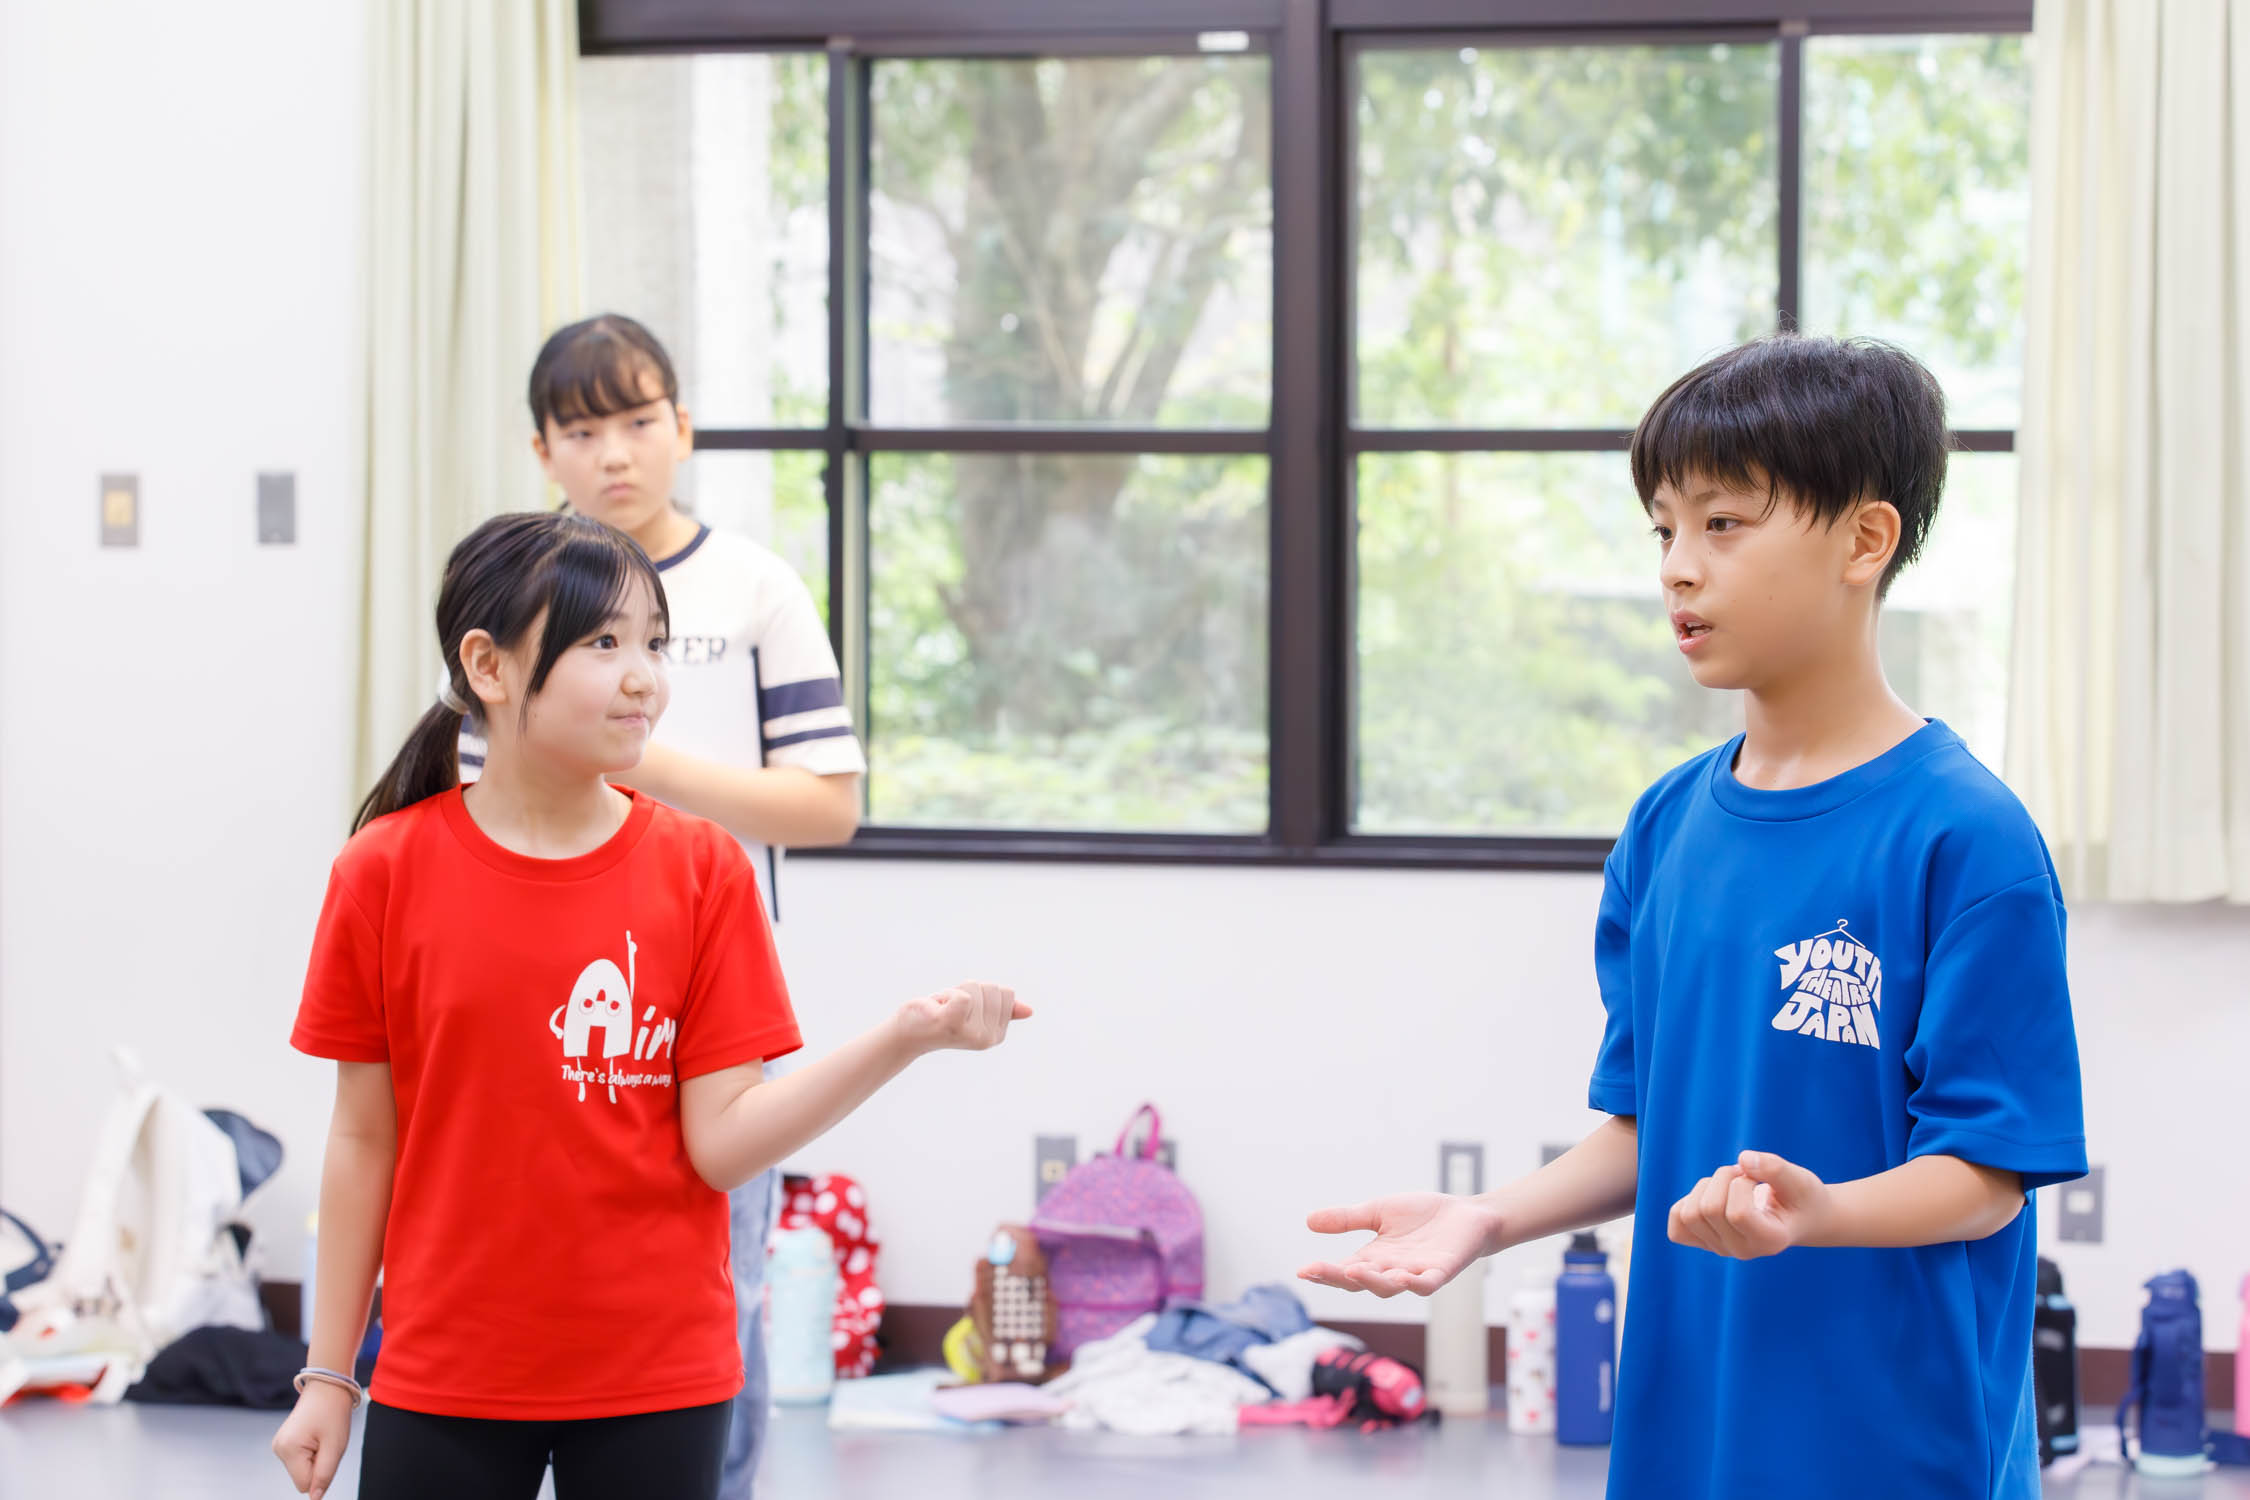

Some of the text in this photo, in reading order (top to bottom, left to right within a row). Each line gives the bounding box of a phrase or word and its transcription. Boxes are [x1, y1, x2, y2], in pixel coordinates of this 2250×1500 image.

[1796, 968, 1872, 1007] THEATRE
[1771, 990, 1881, 1051] JAPAN
[561, 1064, 606, 1084] There's
